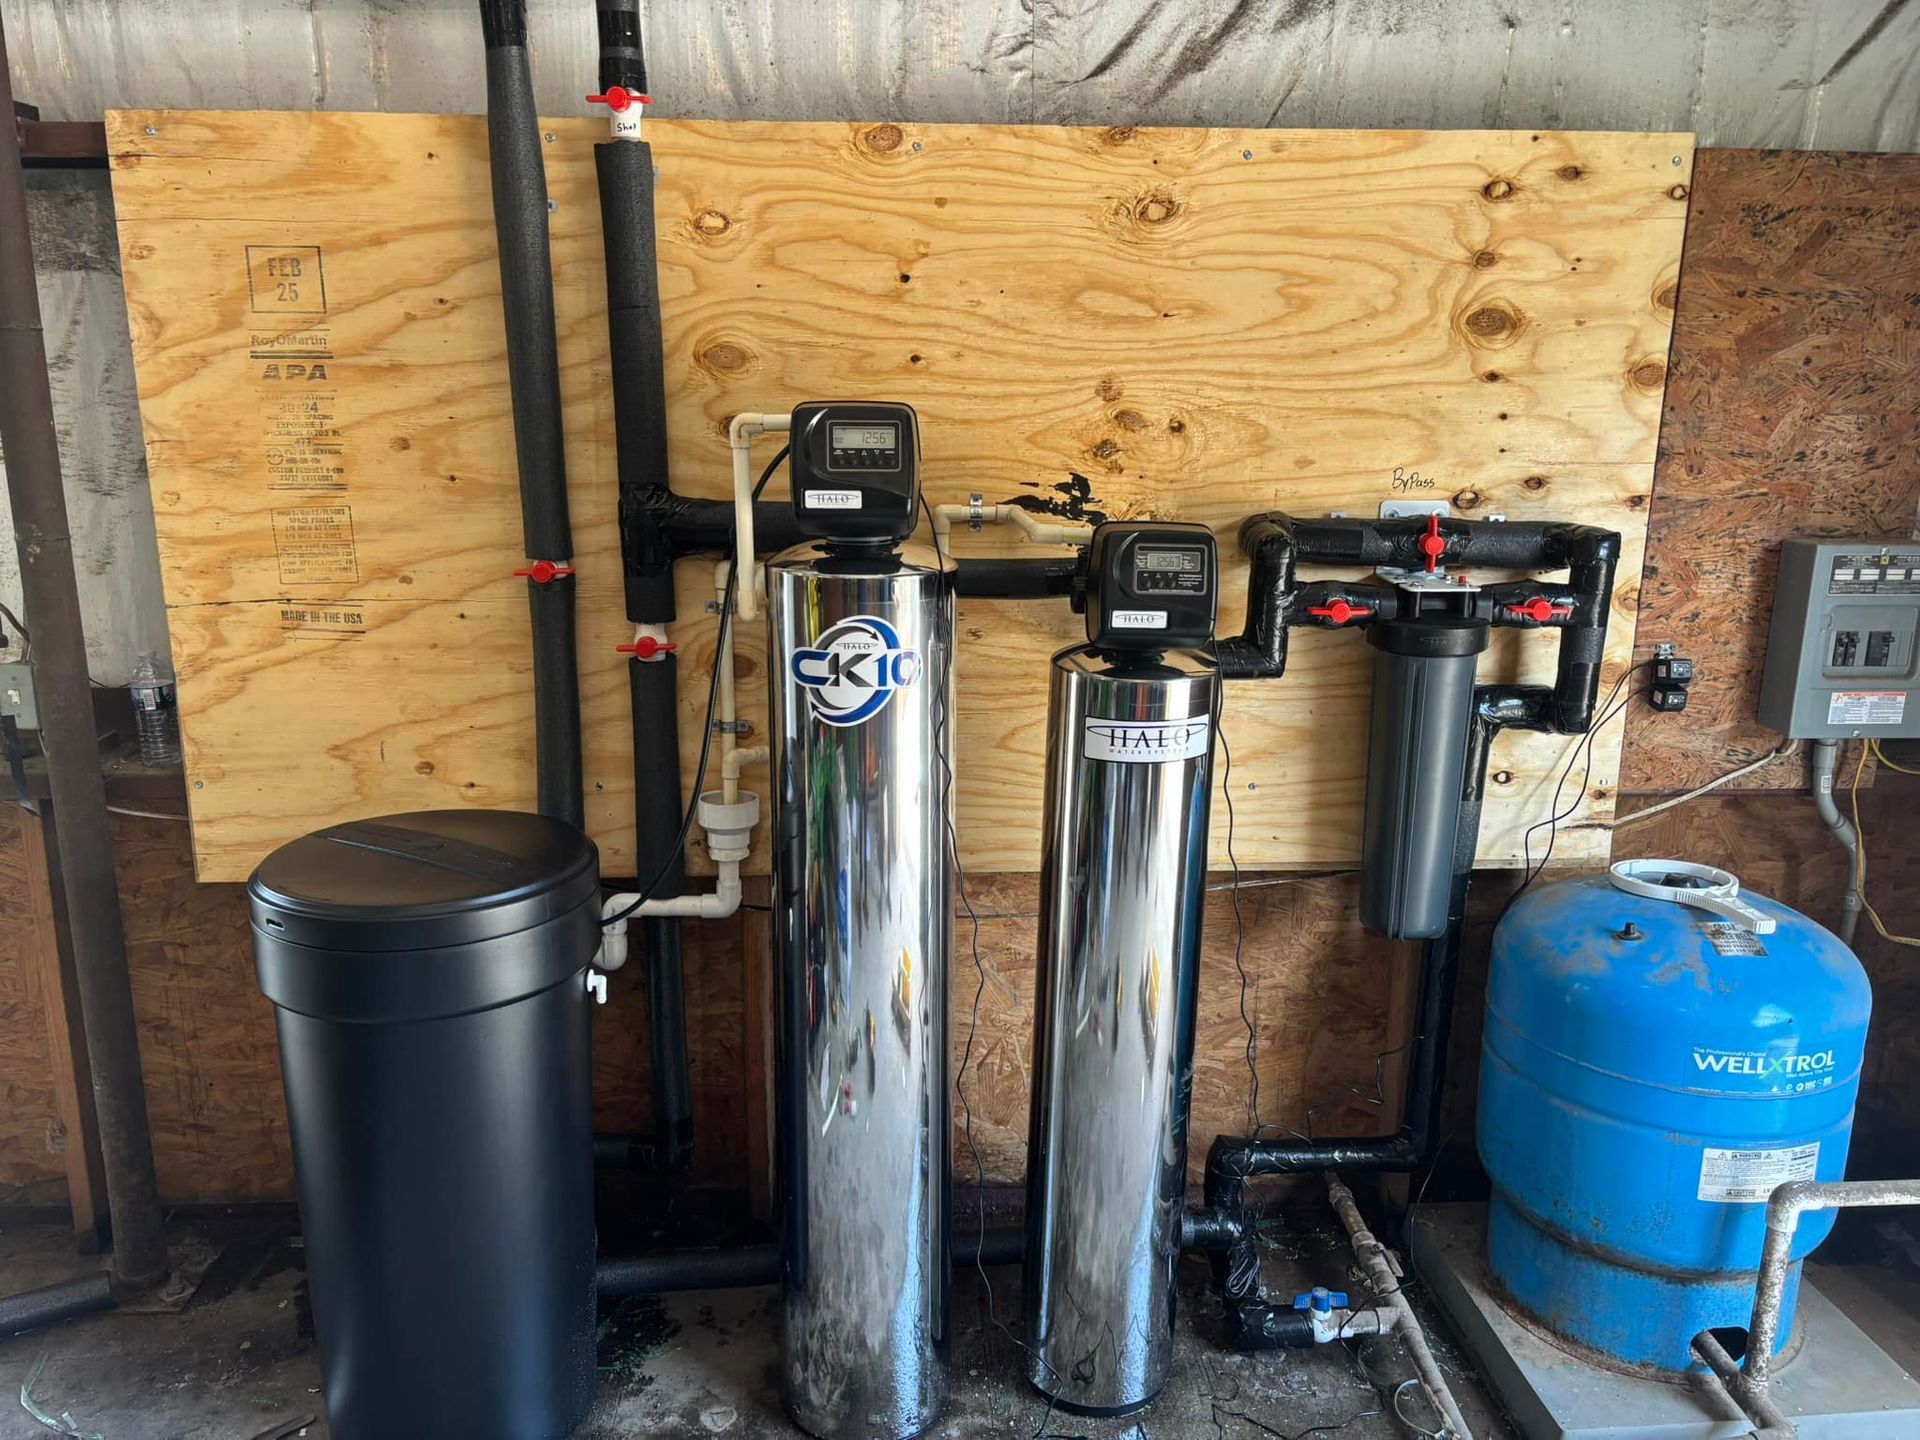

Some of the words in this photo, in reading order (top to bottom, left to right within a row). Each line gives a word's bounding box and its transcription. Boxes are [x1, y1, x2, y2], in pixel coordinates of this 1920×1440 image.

[267, 257, 301, 277] FEB
[277, 283, 299, 301] 25
[261, 364, 327, 380] APA
[817, 494, 849, 504] HALO
[281, 609, 307, 622] MADE
[310, 610, 320, 623] IN
[323, 611, 341, 624] THE
[344, 612, 363, 625] USA
[1124, 614, 1155, 624] HALO
[843, 642, 870, 650] HALO
[791, 650, 922, 688] CK10
[1109, 728, 1190, 748] HALO
